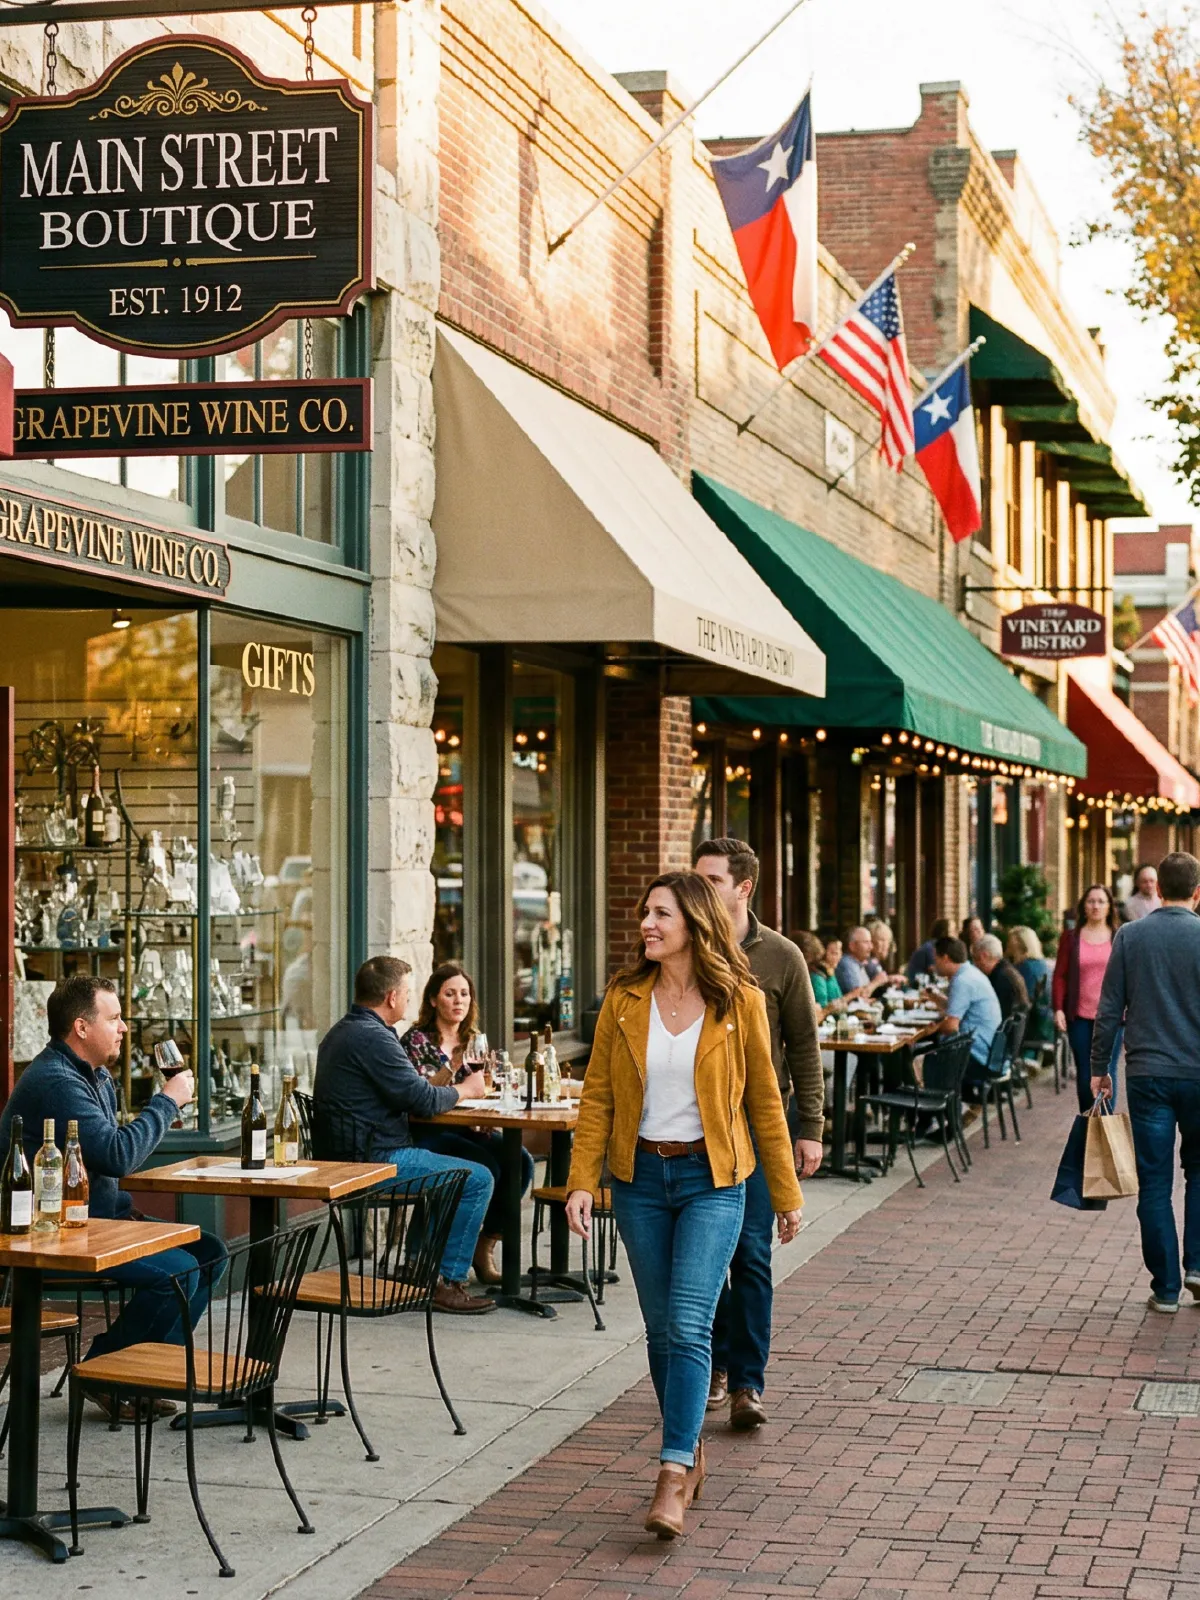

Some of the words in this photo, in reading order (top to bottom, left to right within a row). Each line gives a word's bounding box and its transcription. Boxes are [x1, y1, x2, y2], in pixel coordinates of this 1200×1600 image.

[20, 136, 146, 198] MAIN
[161, 127, 338, 191] STREET
[39, 200, 317, 252] BOUTIQUE
[109, 286, 169, 316] EST.
[181, 284, 243, 314] 1912
[199, 399, 289, 435] WINE
[299, 398, 354, 433] CO.
[130, 530, 187, 580] WINE
[189, 544, 221, 588] CO.
[697, 616, 716, 652] THE
[718, 624, 764, 667] VINEYARD
[1006, 618, 1103, 634] VINEYARD
[1021, 634, 1088, 651] BISTRO
[241, 641, 316, 698] GIFTS
